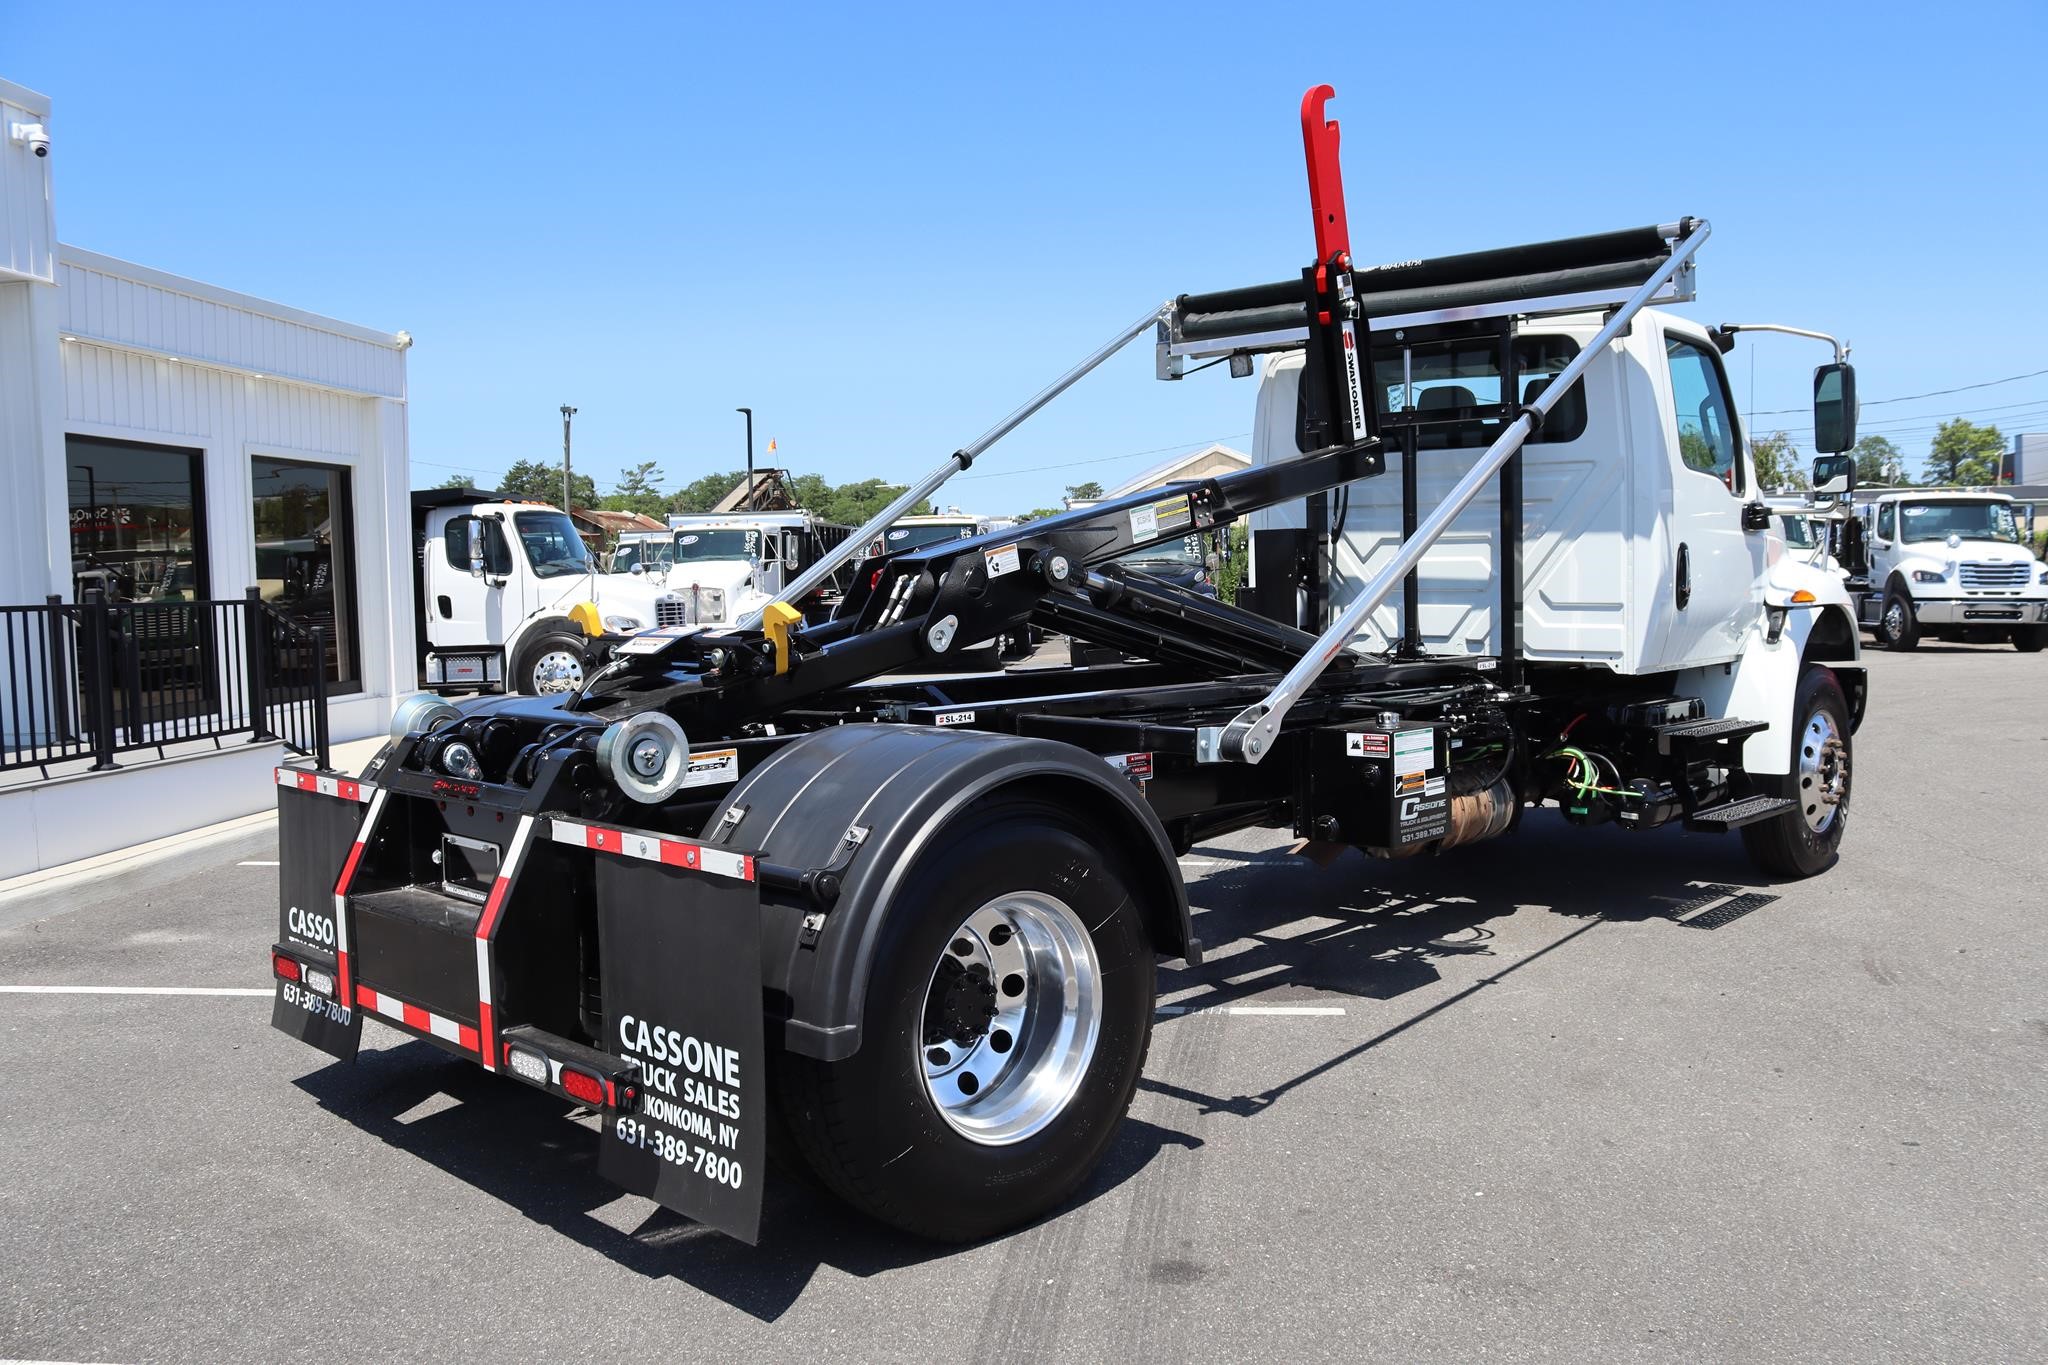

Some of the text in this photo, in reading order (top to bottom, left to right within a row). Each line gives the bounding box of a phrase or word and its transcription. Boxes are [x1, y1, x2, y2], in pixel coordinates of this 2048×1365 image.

[1347, 352, 1361, 430] SWAPLOADER
[945, 713, 972, 723] SL-214
[1400, 797, 1446, 821] CASSONE
[288, 906, 336, 947] CASSO
[283, 983, 352, 1026] 631-389-7800
[619, 1015, 741, 1089] CASSONE
[620, 1053, 741, 1120] UCK SALES
[616, 1117, 743, 1190] 631-389-7800
[719, 1122, 740, 1150] NY
